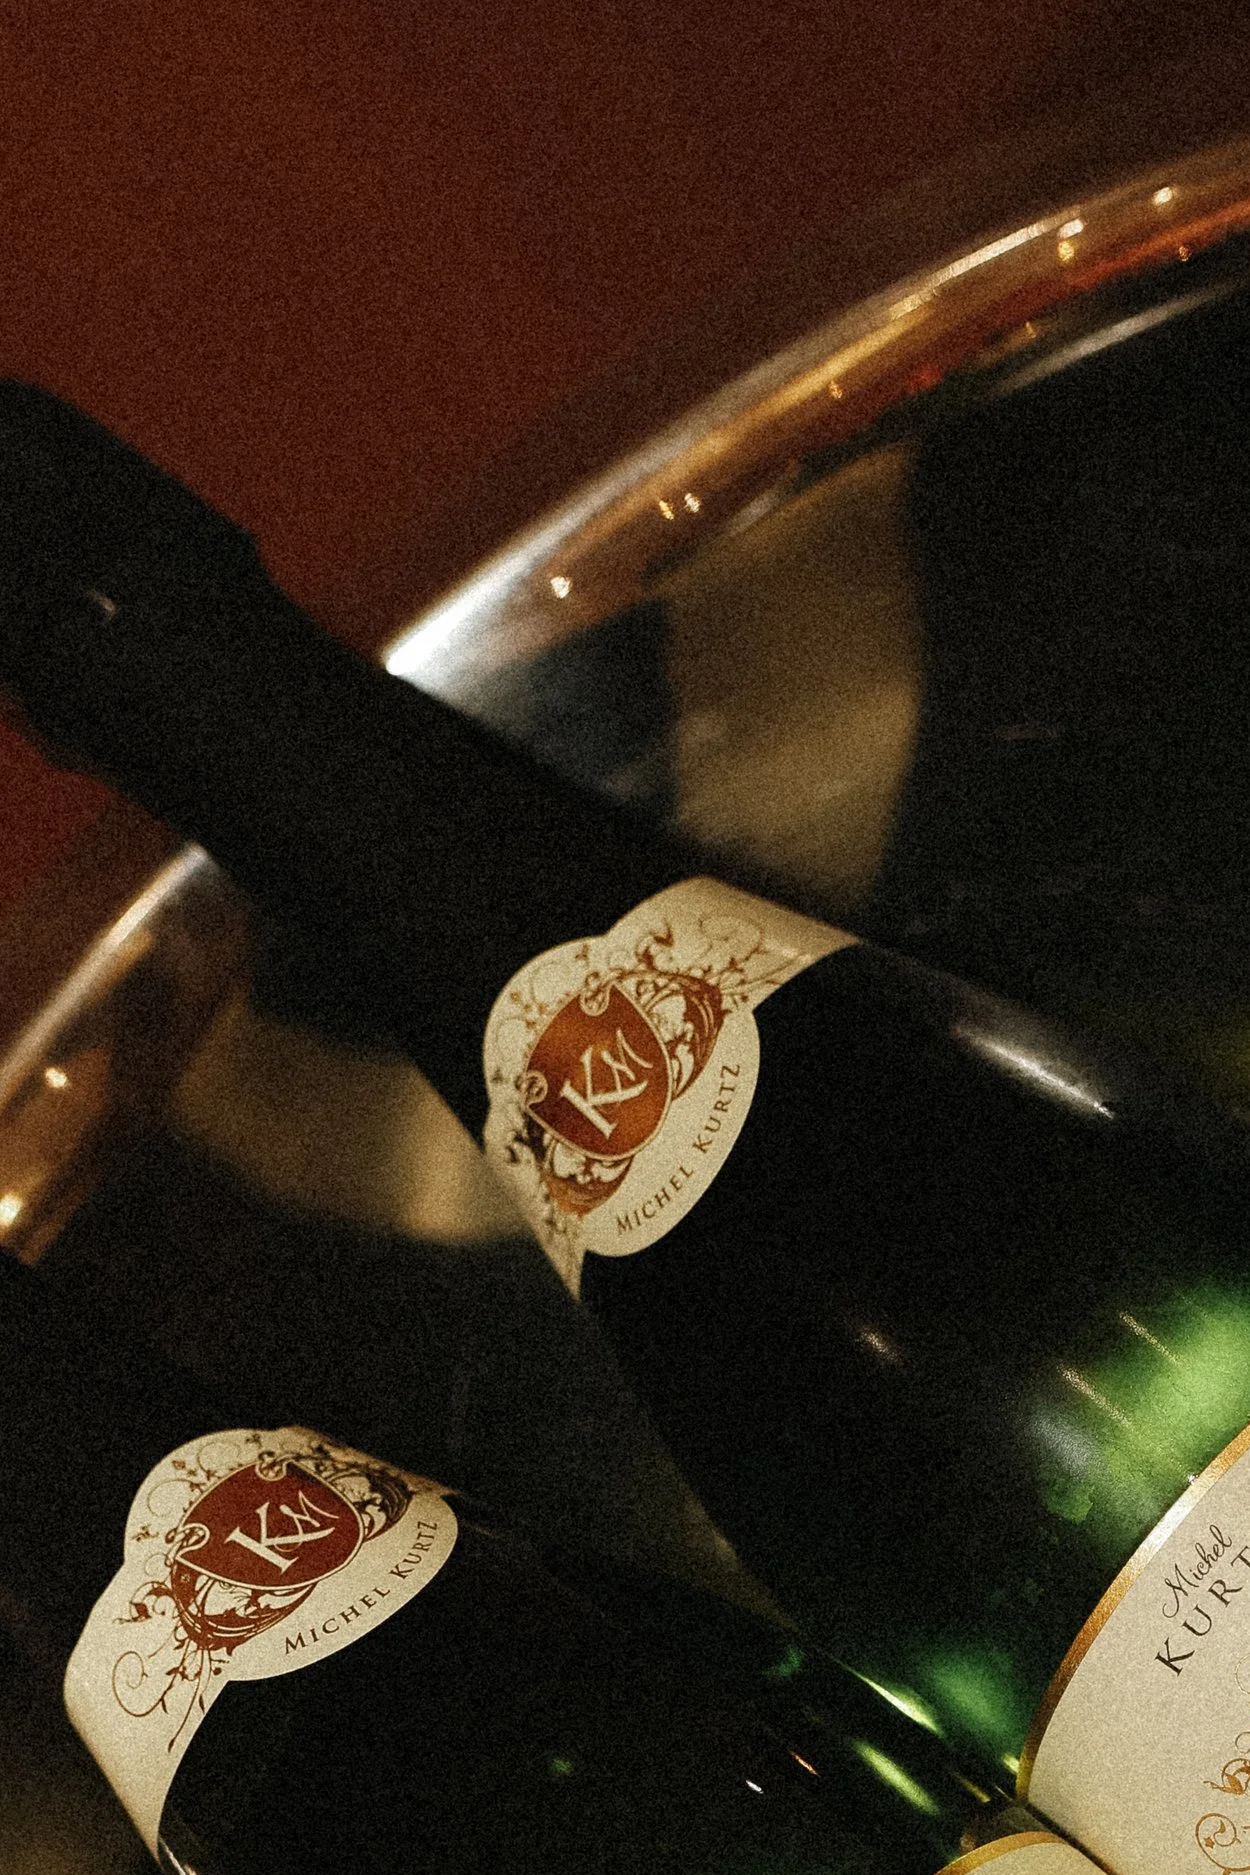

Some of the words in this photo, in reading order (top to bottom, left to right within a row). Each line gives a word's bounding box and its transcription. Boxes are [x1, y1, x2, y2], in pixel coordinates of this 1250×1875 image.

[560, 1028, 654, 1140] KM
[614, 1166, 694, 1236] MICHEL
[692, 1063, 741, 1154] KURTZ
[223, 1490, 339, 1576] KM
[284, 1585, 391, 1655] MICHEL
[389, 1520, 439, 1581] KURTZ
[1161, 1524, 1233, 1619] Michel
